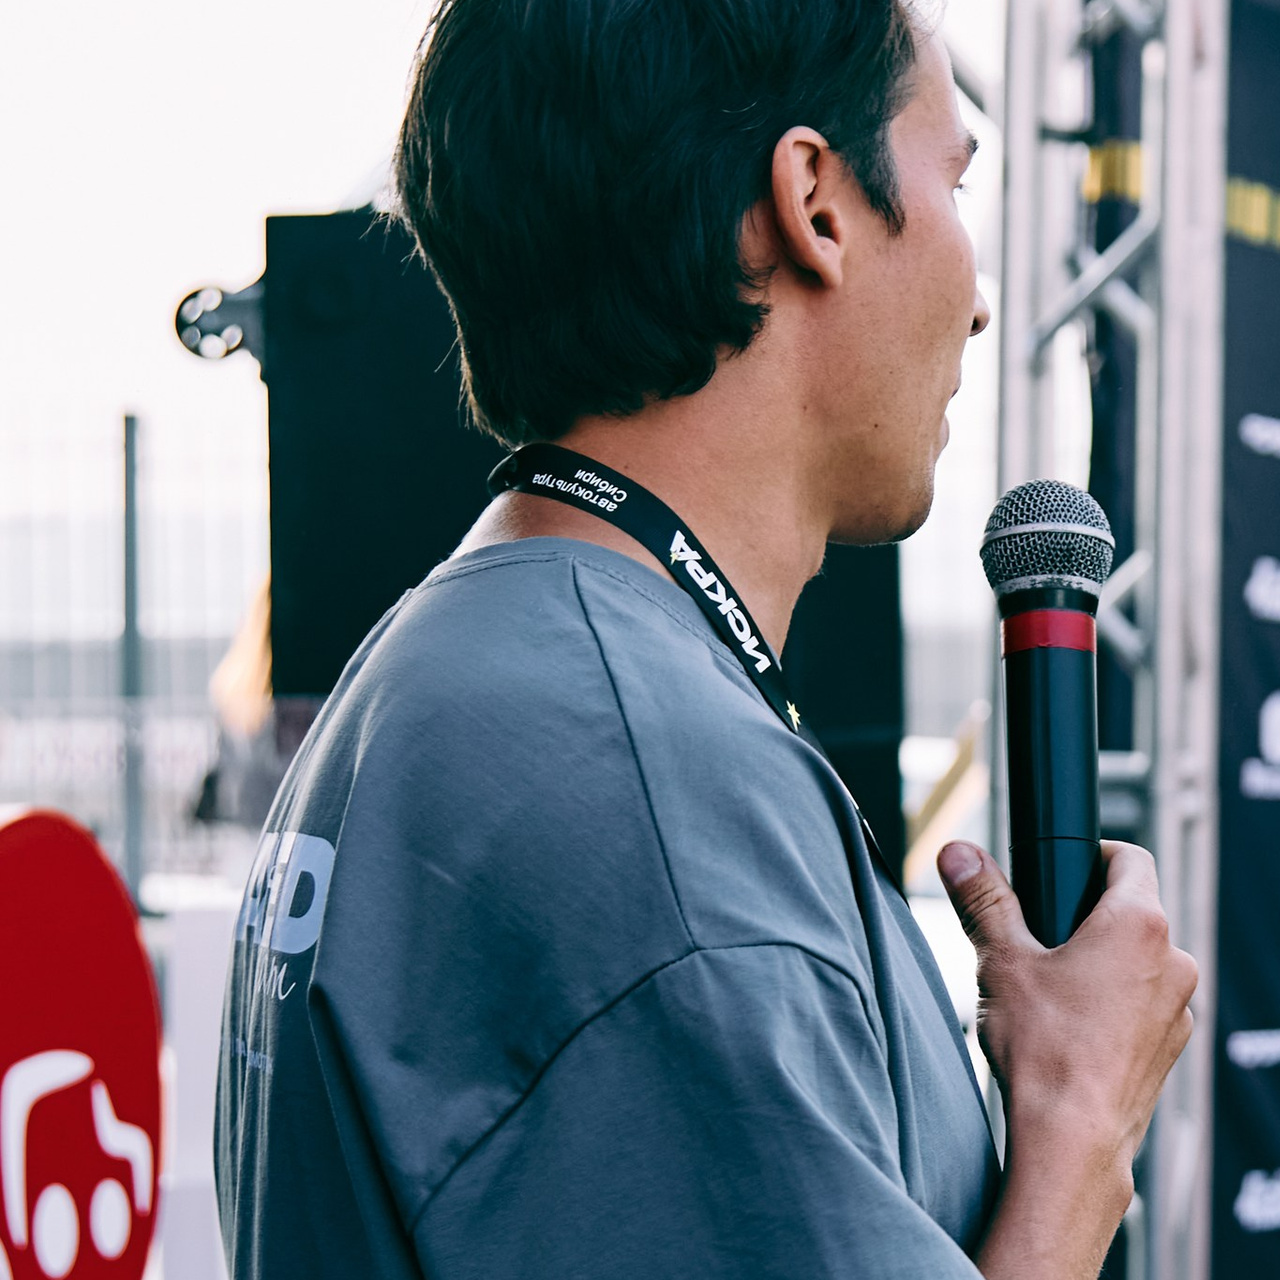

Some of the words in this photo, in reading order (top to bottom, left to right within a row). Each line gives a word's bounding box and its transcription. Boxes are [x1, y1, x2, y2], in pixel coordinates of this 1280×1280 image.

[532, 473, 618, 512] автокультура
[574, 469, 628, 502] Сибири
[669, 530, 772, 673] ИСКРА
